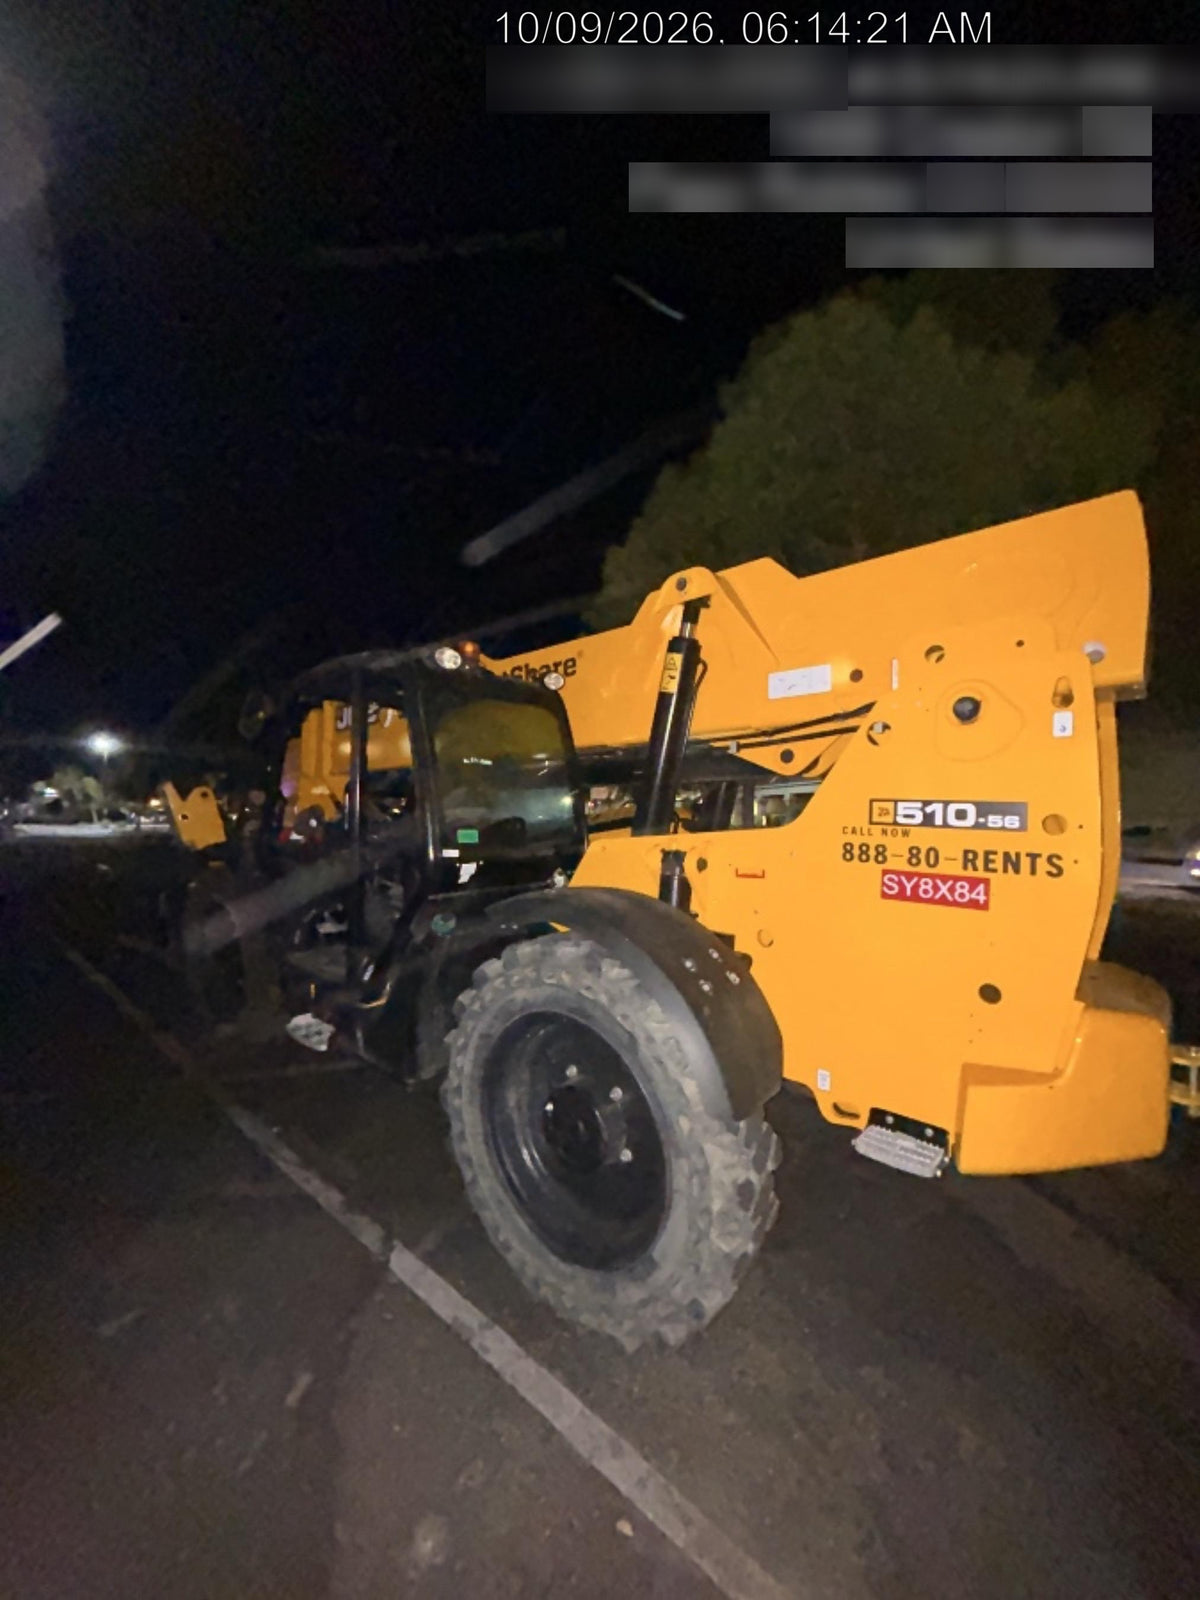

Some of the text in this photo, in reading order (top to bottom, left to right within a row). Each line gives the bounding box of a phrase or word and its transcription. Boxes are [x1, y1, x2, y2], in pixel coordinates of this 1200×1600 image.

[895, 801, 1020, 828] 510-56
[842, 826, 911, 838] CALL NOW
[842, 842, 1064, 878] 888-80-RENTS
[882, 873, 987, 904] SY8X84
